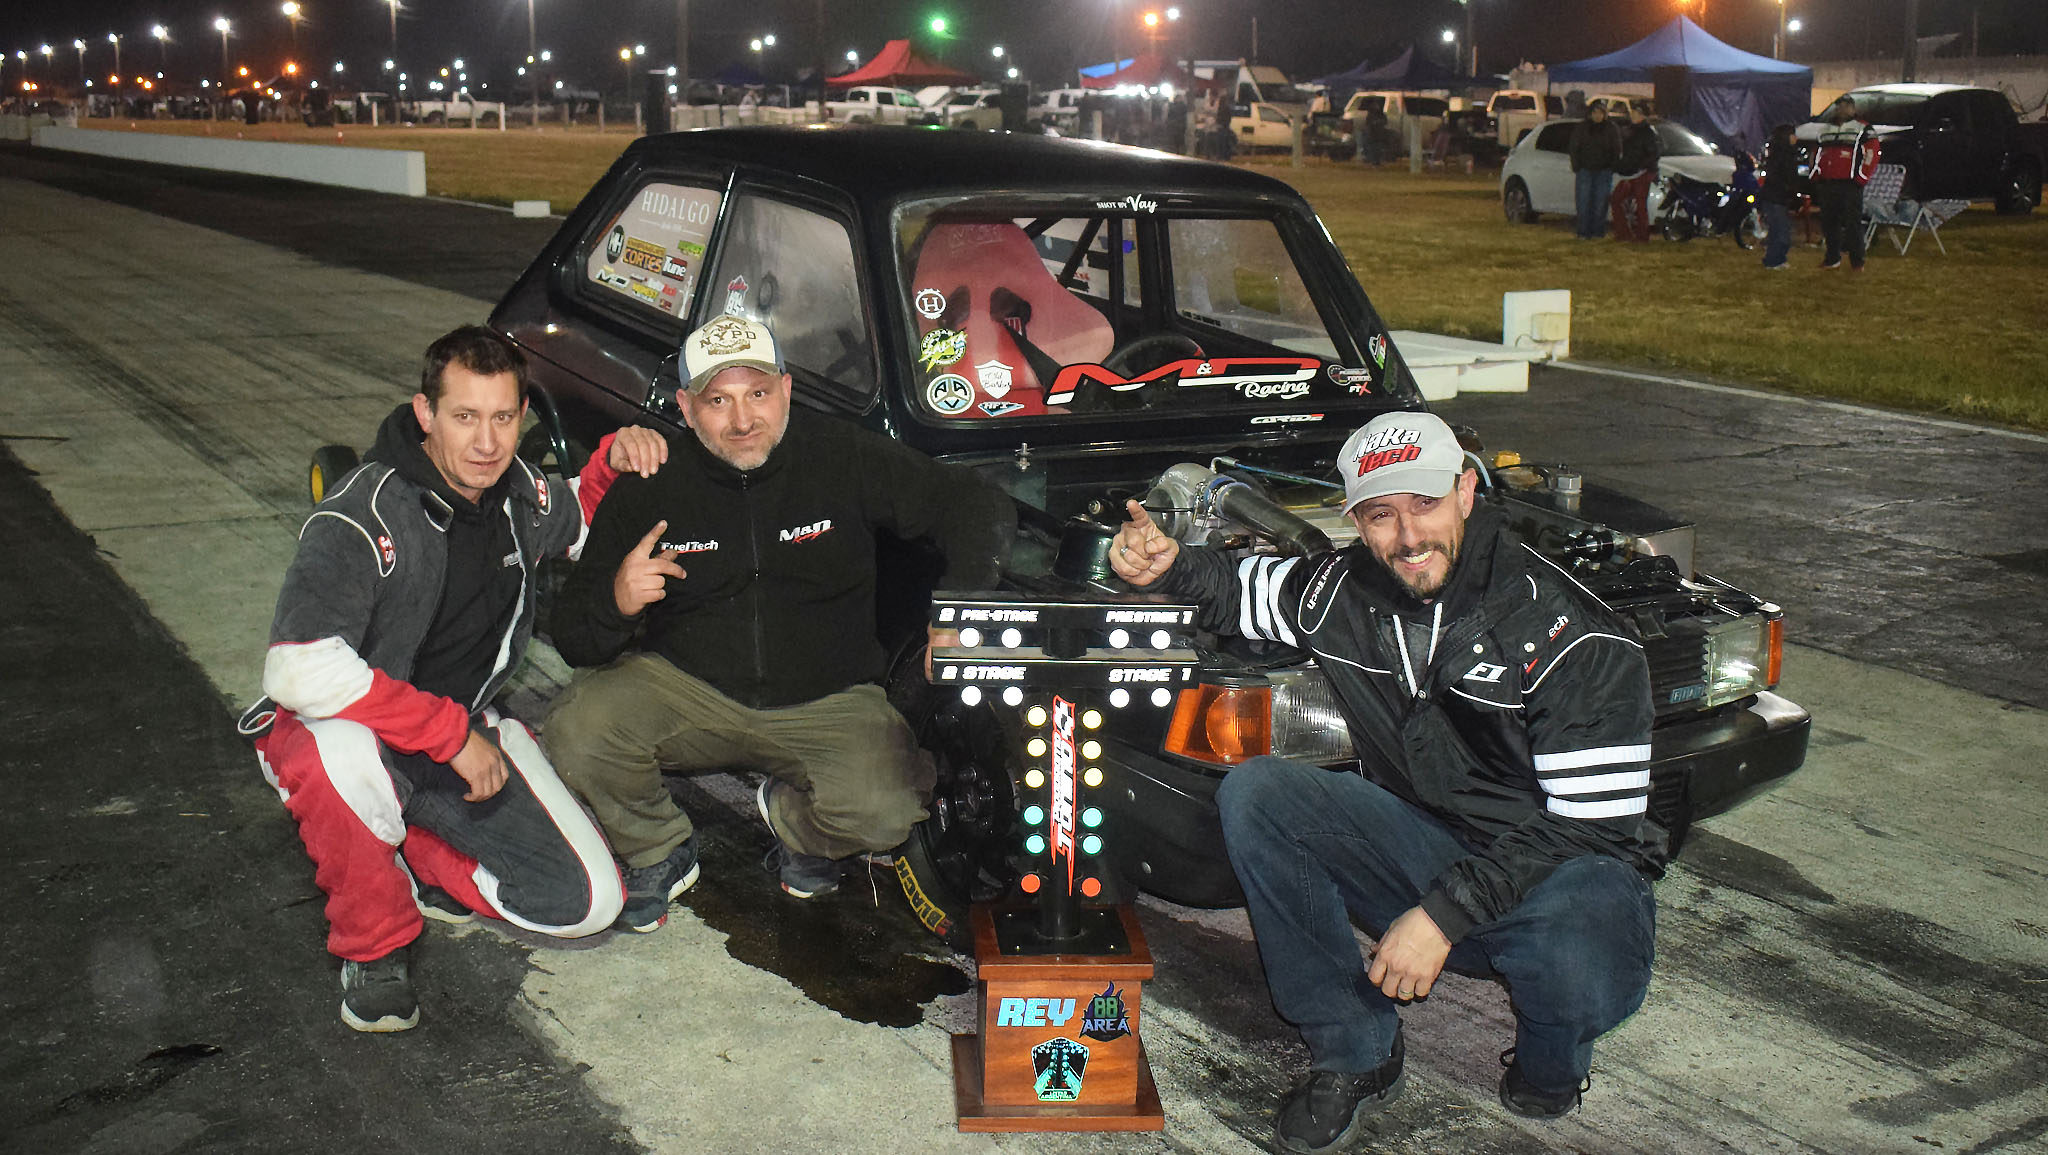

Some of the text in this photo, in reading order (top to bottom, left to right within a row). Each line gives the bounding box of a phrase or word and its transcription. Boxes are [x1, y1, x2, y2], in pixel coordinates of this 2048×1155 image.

[642, 191, 709, 224] HIDALGO
[1126, 194, 1158, 213] Vay
[623, 249, 661, 273] CORTES
[663, 256, 686, 276] Tune
[700, 330, 756, 348] NYPD
[1235, 381, 1311, 400] Racing
[1358, 444, 1421, 477] Tech
[660, 540, 719, 551] FuelTech
[960, 609, 1039, 622] PRE-STAGE
[962, 666, 1026, 680] STAGE
[1108, 668, 1172, 682] STAGE
[1672, 686, 1704, 702] FIAT
[996, 997, 1077, 1027] REY
[1081, 1016, 1130, 1035] AREA
